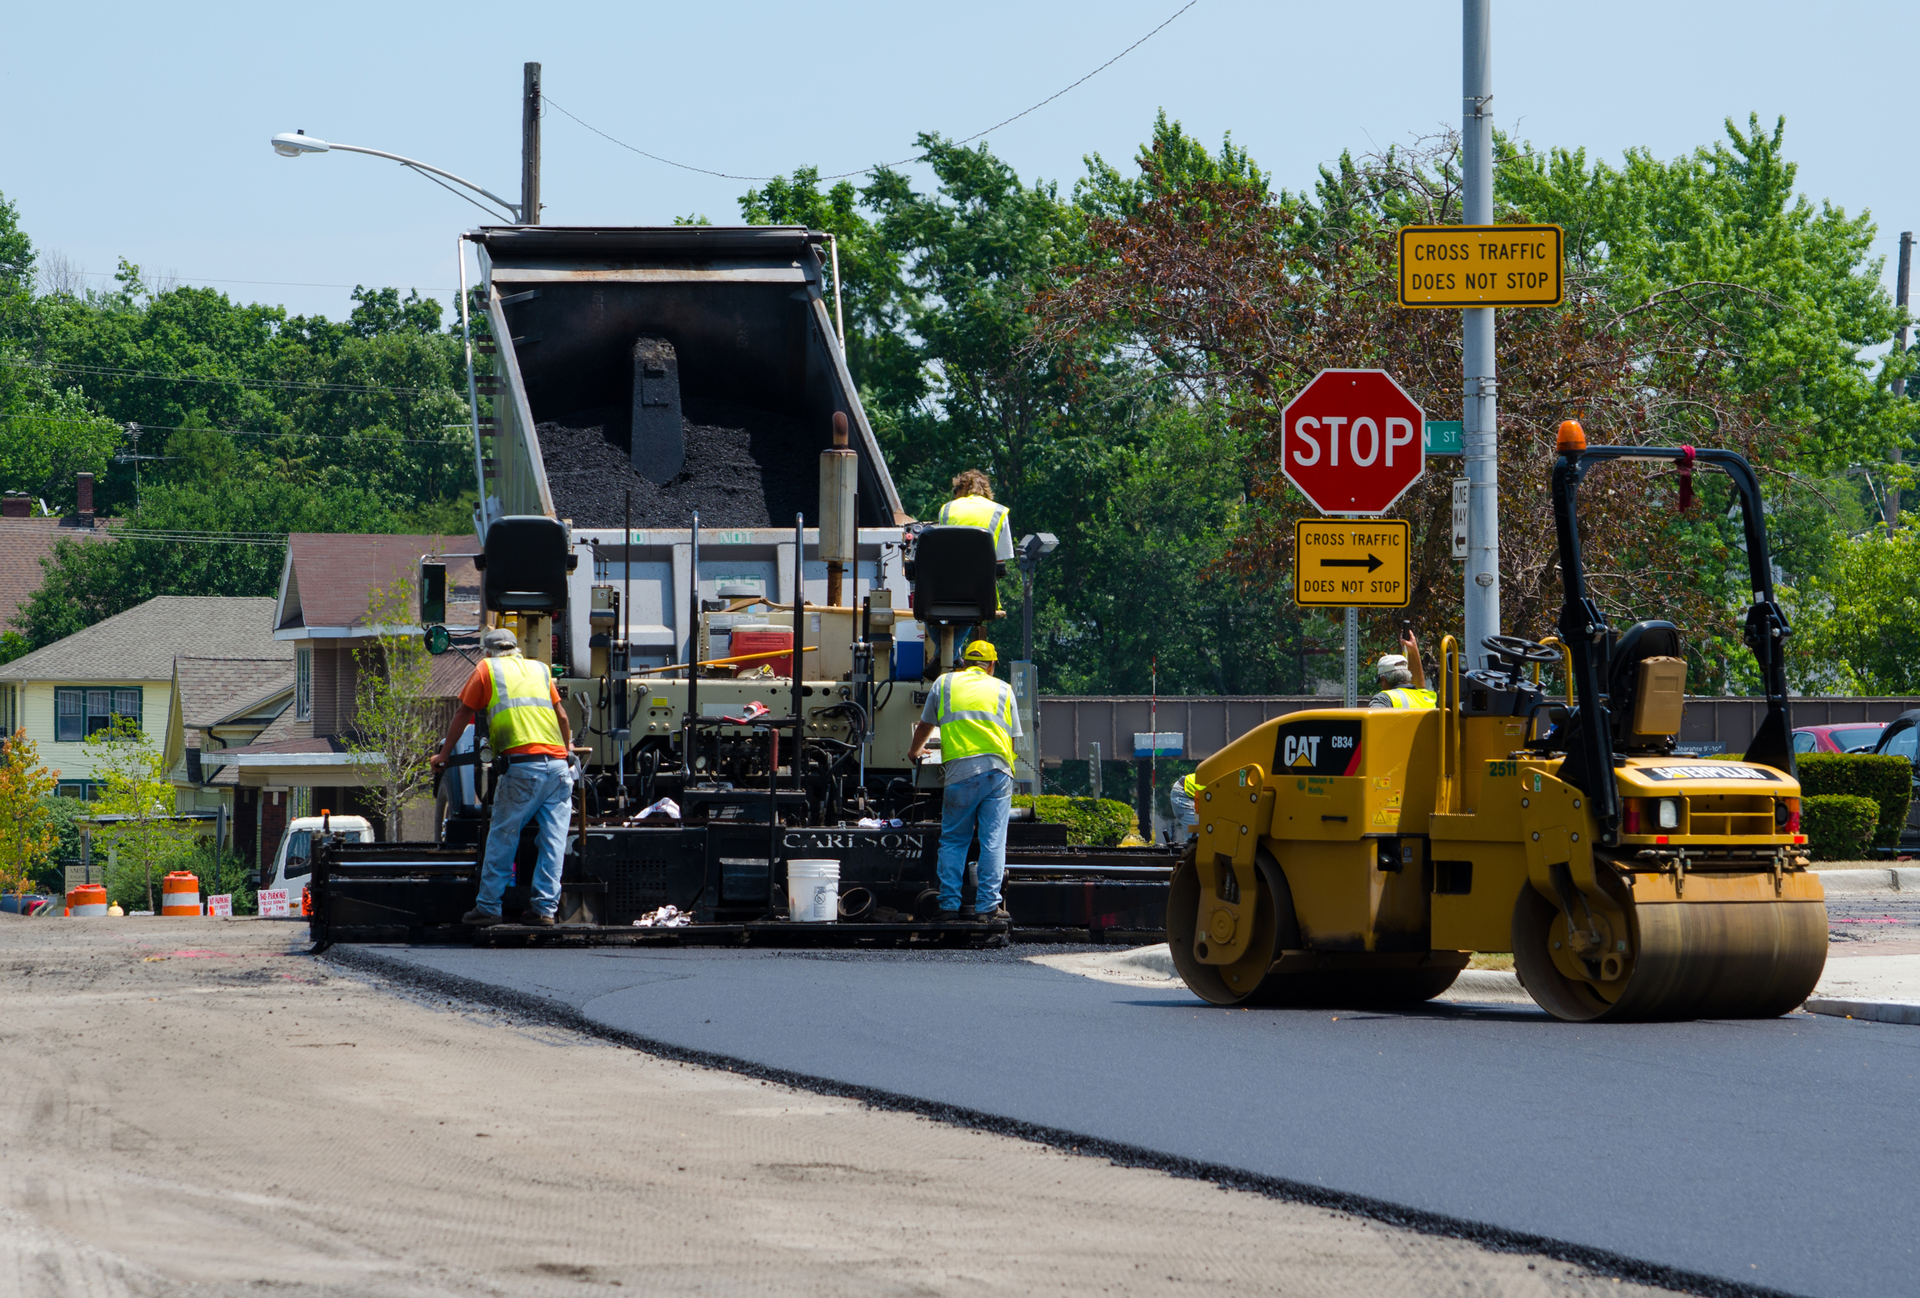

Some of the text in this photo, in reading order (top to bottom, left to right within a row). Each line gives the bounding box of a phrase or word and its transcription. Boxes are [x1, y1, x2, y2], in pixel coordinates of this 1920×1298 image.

[1415, 243, 1546, 261] CROSS TRAFFIC
[1412, 272, 1548, 290] DOES NOT STOP
[1293, 415, 1414, 467] STOP
[1443, 431, 1456, 443] ST
[1454, 485, 1467, 504] ONE
[1454, 507, 1467, 526] WAY
[719, 531, 754, 544] NOT
[1305, 533, 1400, 546] CROSS TRAFFIC
[1304, 580, 1400, 593] DOES NOT STOP
[1141, 736, 1177, 745] Dre-Up
[1331, 736, 1353, 748] CB34
[1284, 735, 1320, 767] CAT
[1489, 761, 1517, 777] 2511
[1652, 766, 1767, 780] CATERPILLAR
